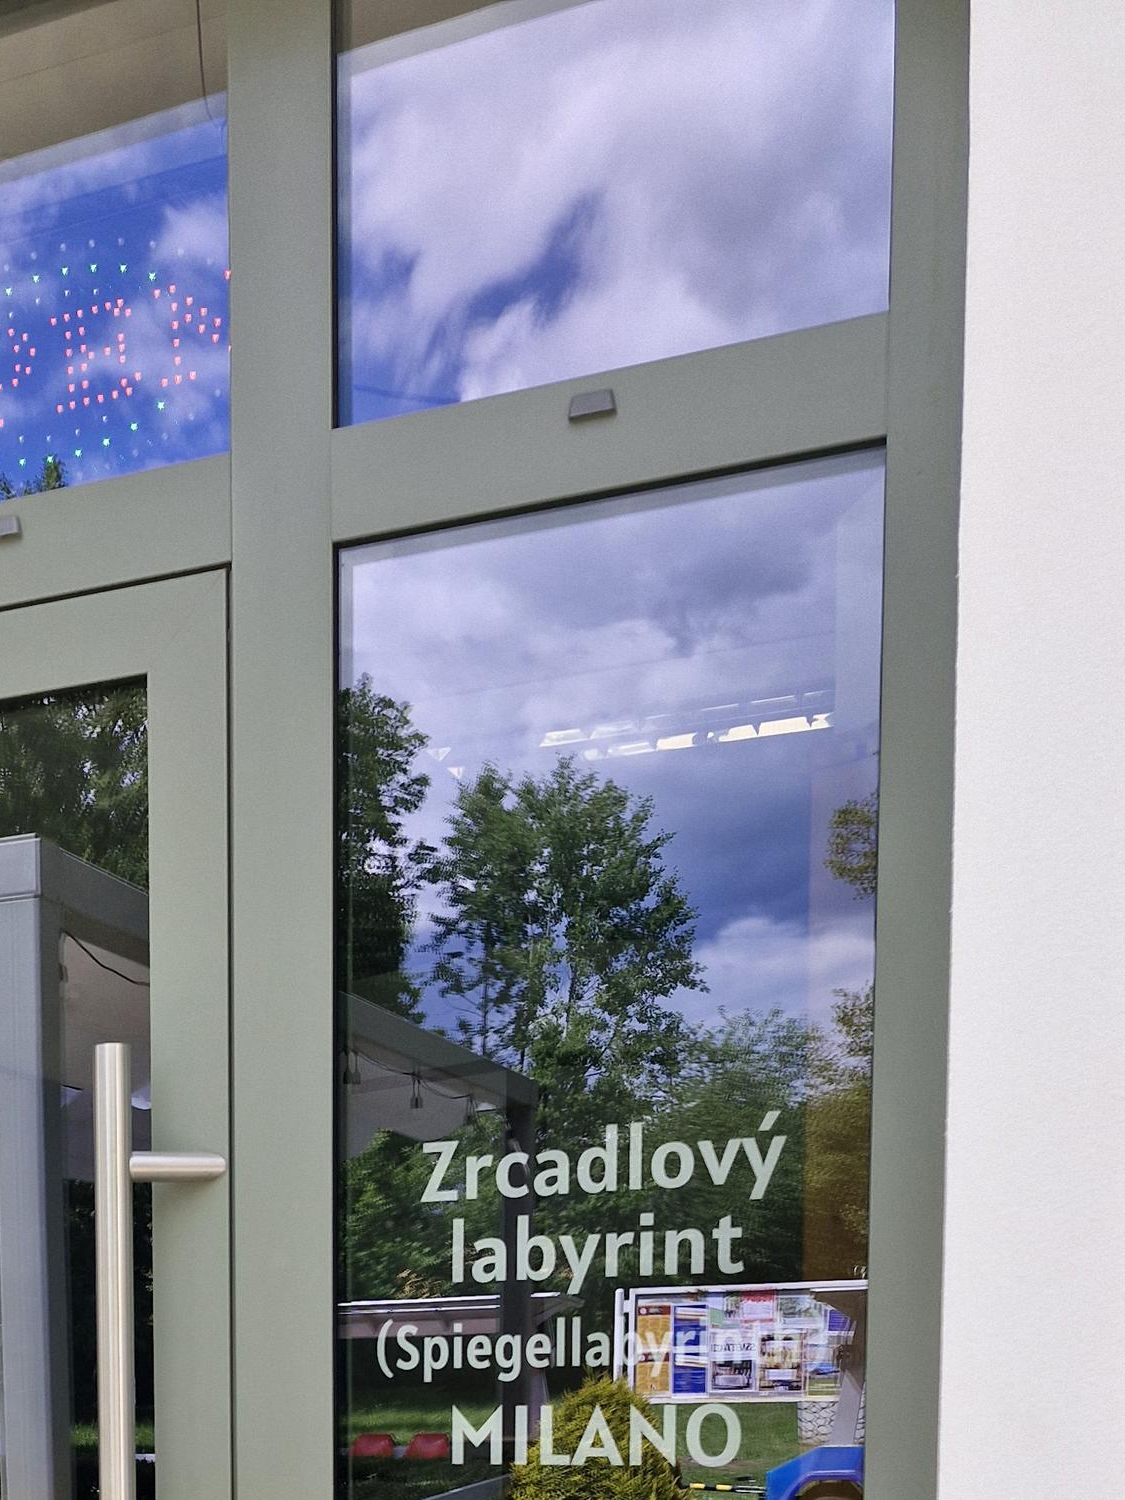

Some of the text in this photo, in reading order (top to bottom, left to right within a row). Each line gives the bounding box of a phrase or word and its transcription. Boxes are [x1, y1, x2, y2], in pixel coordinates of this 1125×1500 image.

[420, 1110, 787, 1203] Zrcadlový
[451, 1212, 744, 1294] labyrint
[451, 1402, 742, 1468] MILANO
